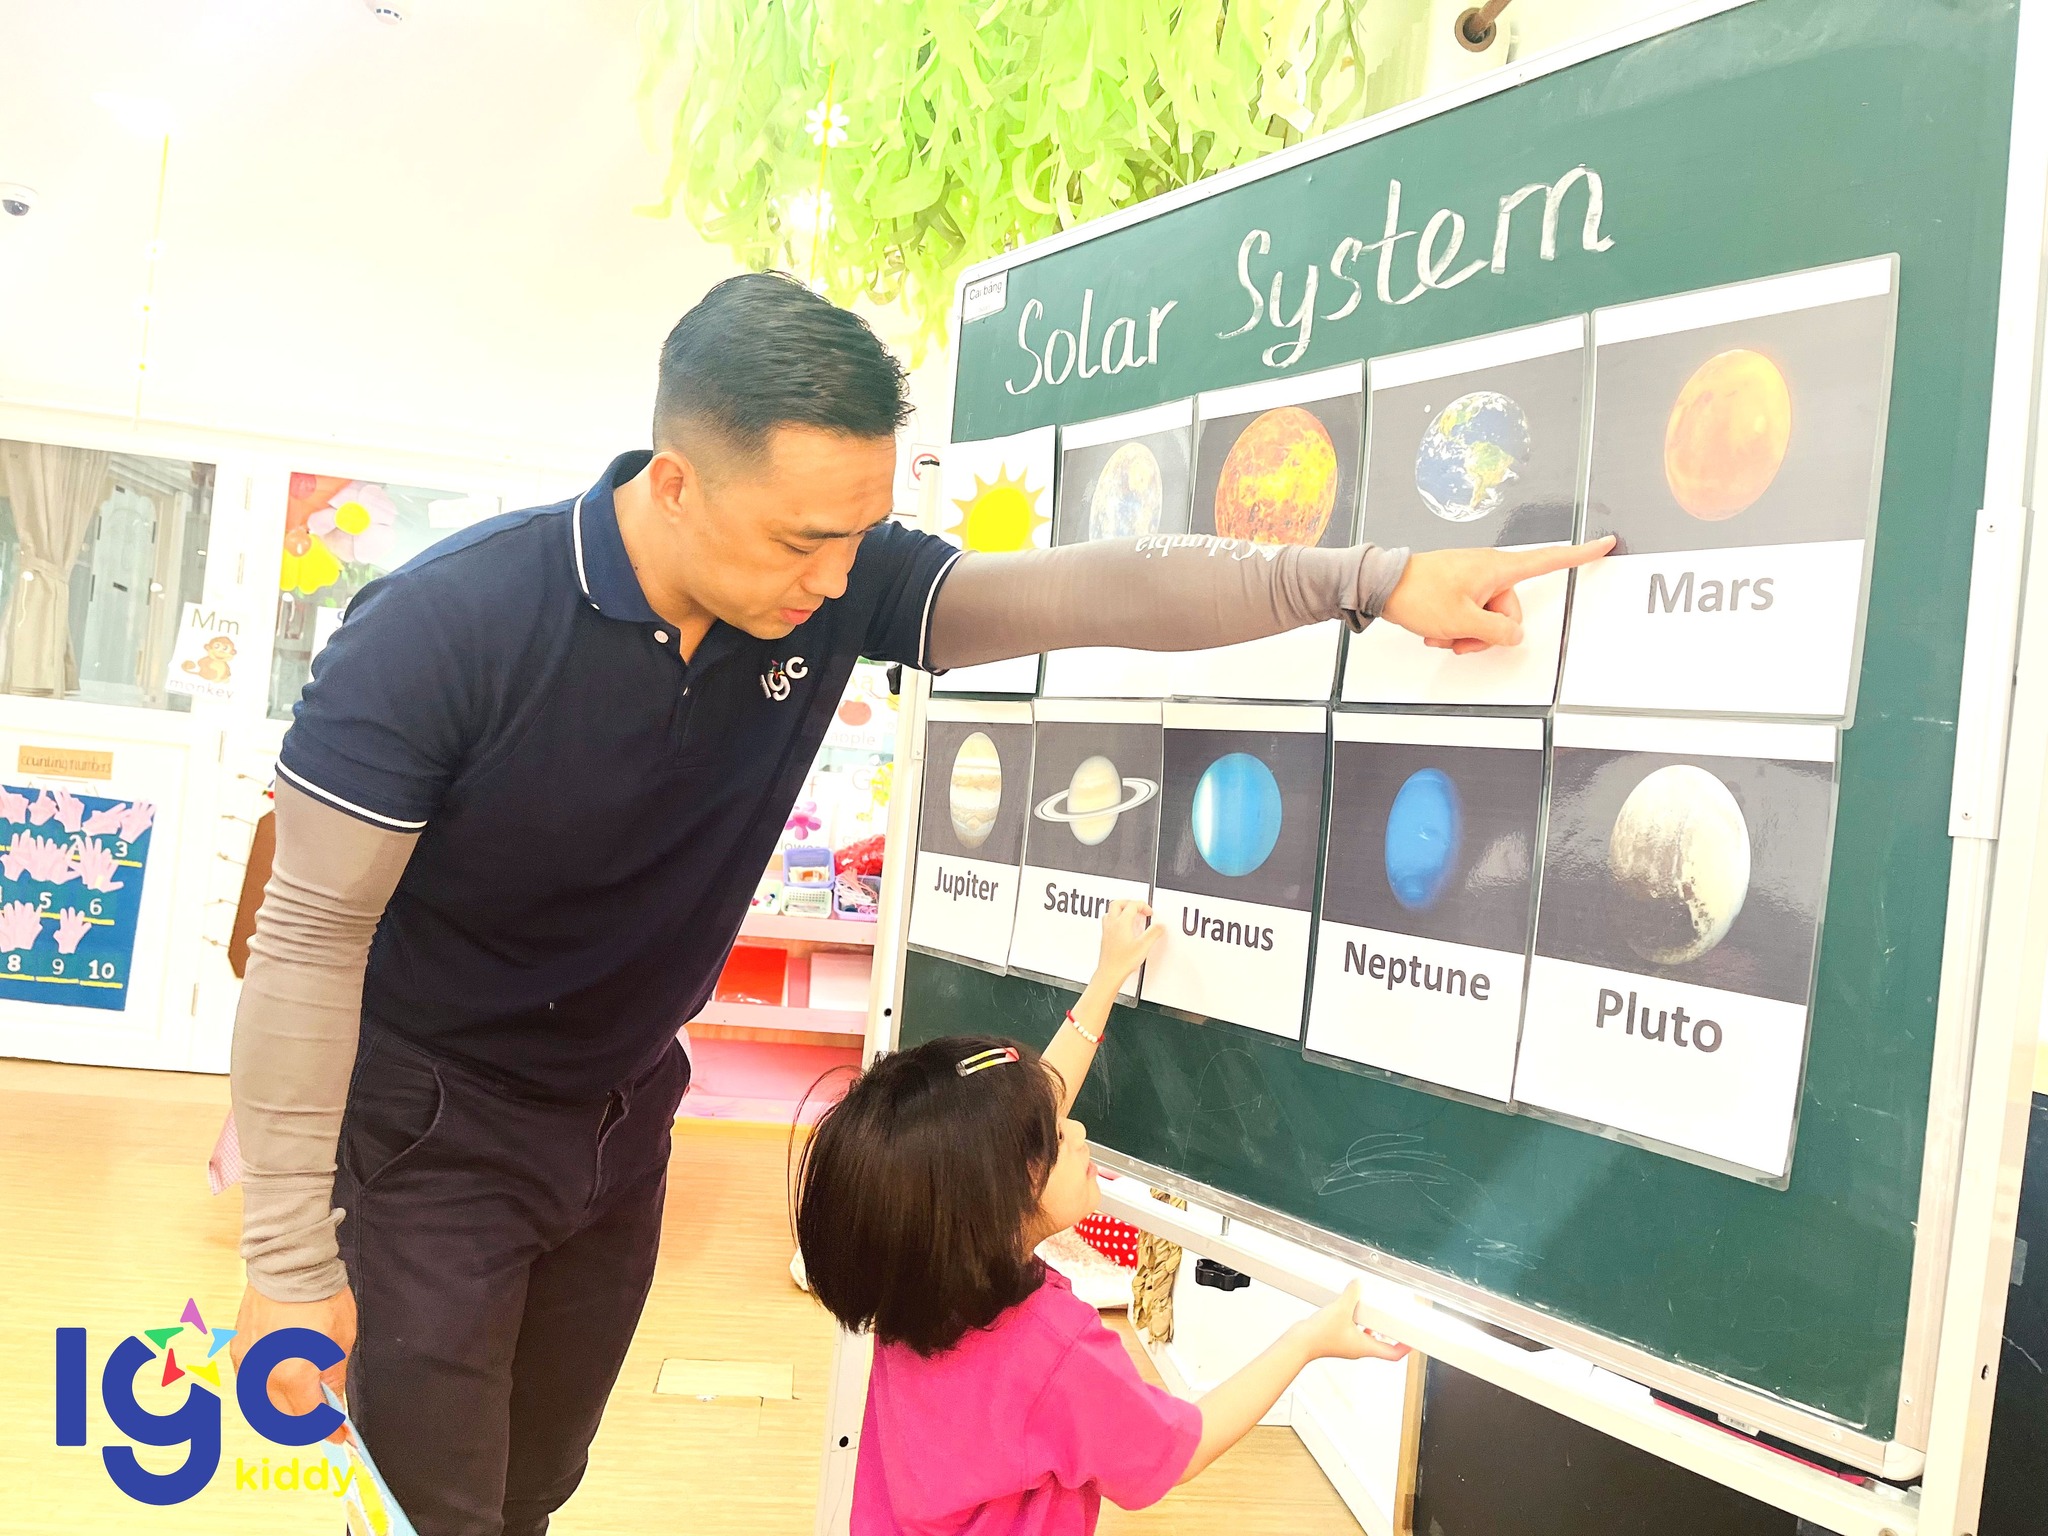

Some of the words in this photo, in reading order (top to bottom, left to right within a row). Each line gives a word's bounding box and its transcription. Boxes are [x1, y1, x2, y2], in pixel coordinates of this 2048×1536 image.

[1005, 289, 1178, 396] Solar
[1215, 163, 1616, 368] System
[1647, 572, 1775, 615] Mars
[192, 607, 240, 635] Mm
[169, 679, 235, 700] monkey
[115, 841, 129, 858] 3
[934, 866, 999, 902] Jupiter
[38, 891, 53, 909] 5
[89, 897, 103, 916] 6
[1182, 906, 1274, 951] Uranus
[6, 954, 22, 972] 8
[51, 958, 65, 975] 9
[88, 959, 115, 980] 10
[1344, 941, 1491, 1001] Neptune
[1596, 987, 1723, 1053] Pluto
